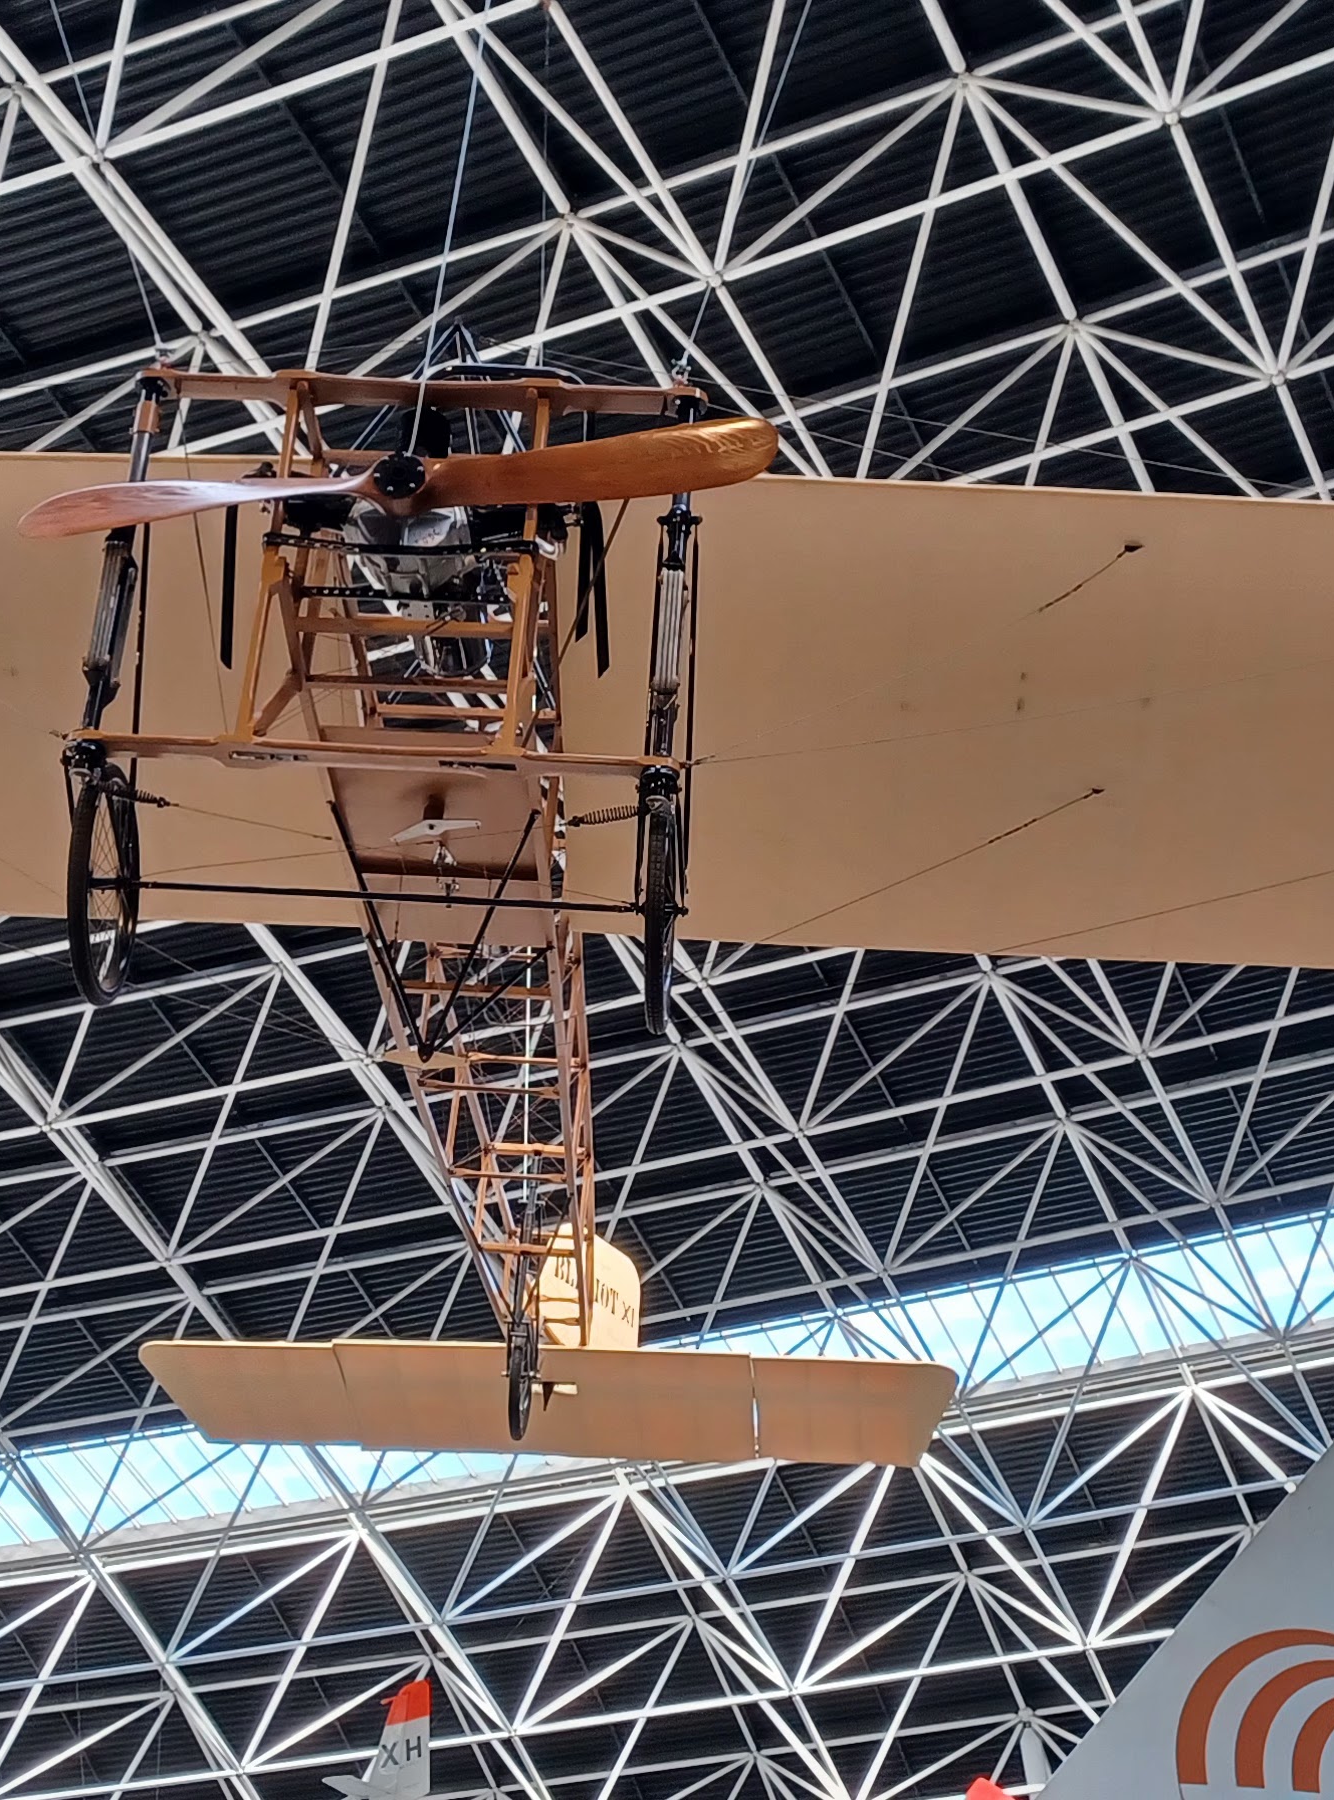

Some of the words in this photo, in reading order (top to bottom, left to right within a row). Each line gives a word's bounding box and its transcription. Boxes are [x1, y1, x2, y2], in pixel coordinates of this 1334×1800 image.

[554, 1255, 619, 1315] BLIOT
[621, 1300, 635, 1328] XI
[380, 1735, 422, 1768] XH
